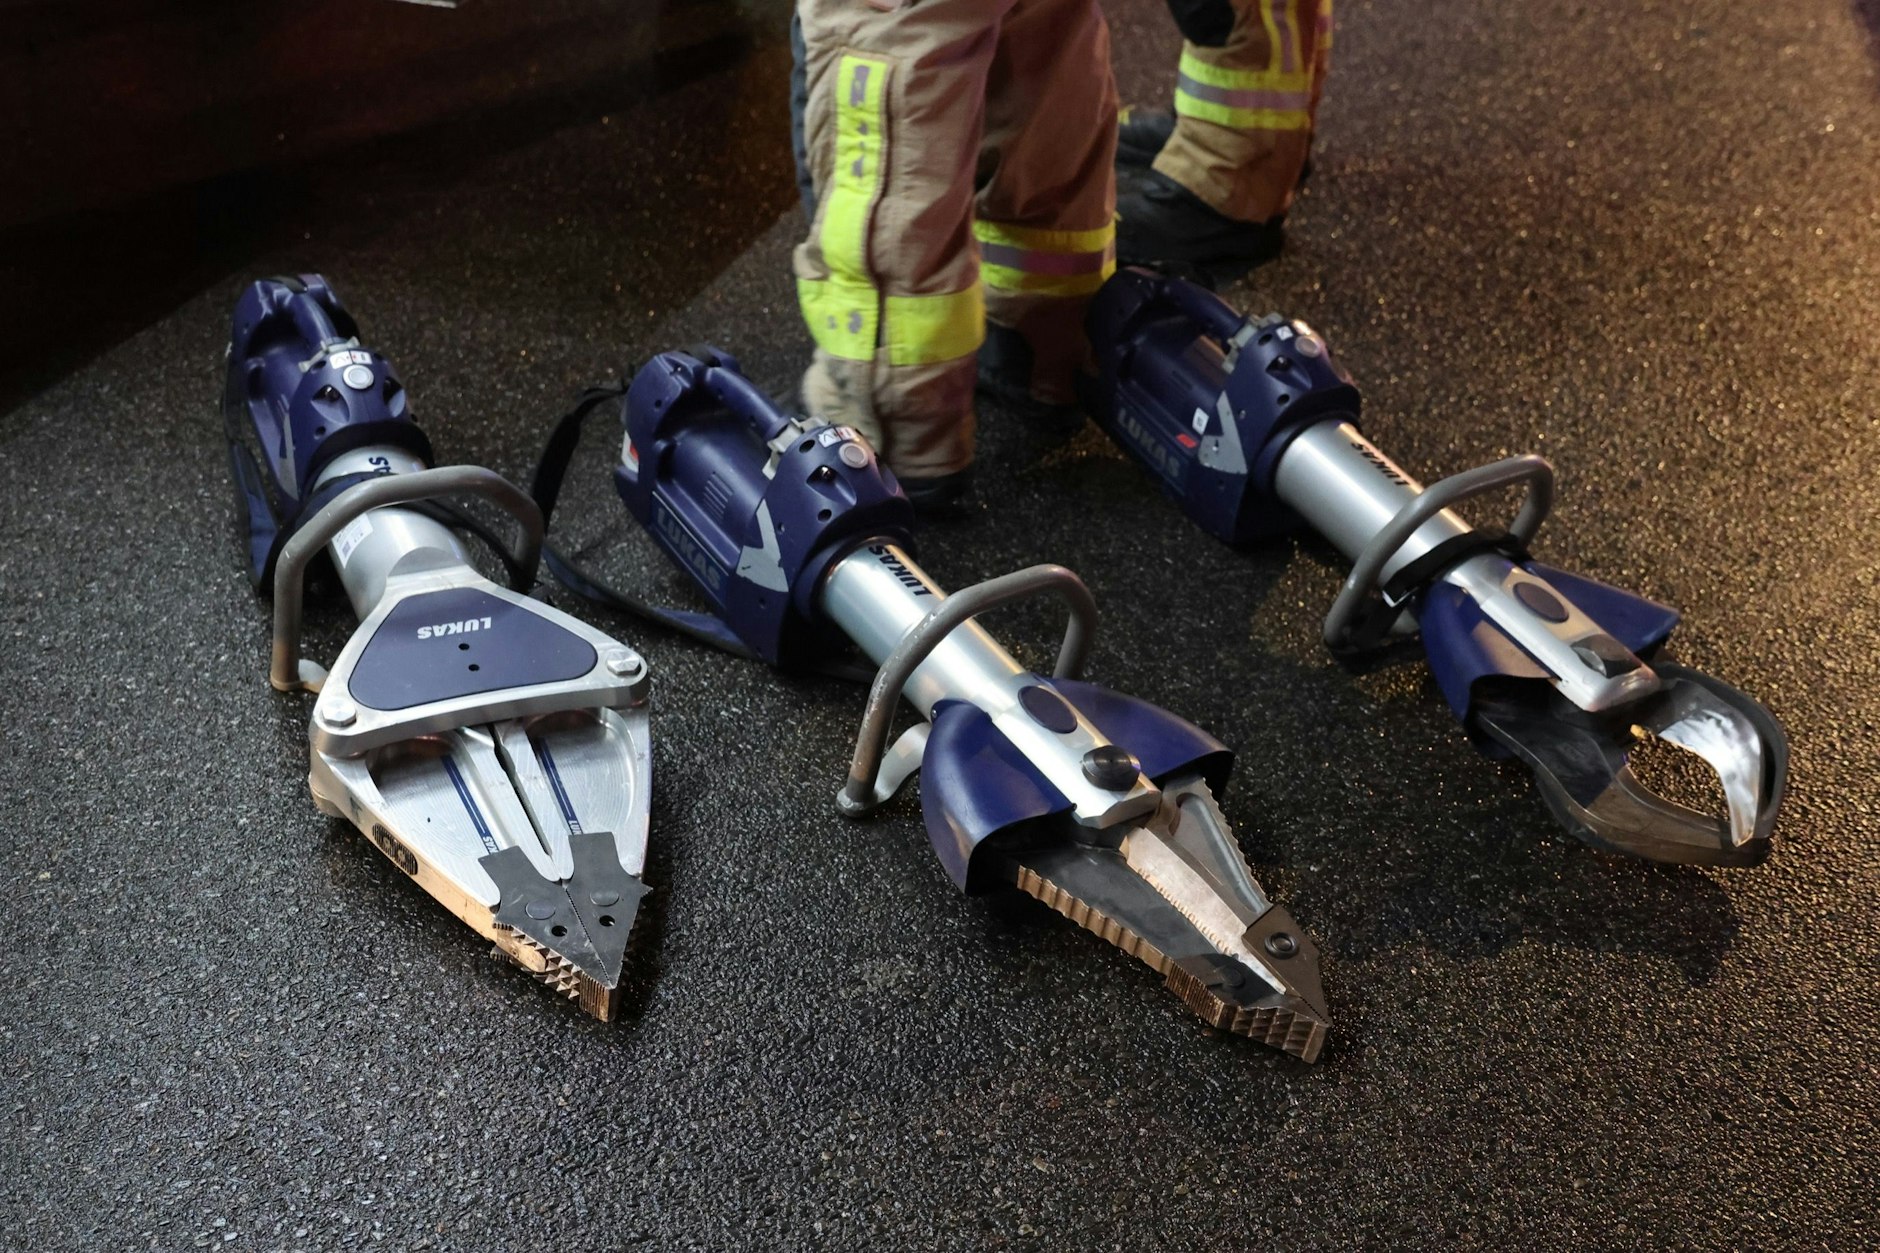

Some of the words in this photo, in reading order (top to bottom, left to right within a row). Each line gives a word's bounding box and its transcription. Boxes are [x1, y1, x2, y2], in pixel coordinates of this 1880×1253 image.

[1118, 407, 1180, 477] LUKAS
[657, 507, 721, 590] LUKAS
[868, 544, 932, 596] LUKAS
[417, 616, 491, 640] LUKAS
